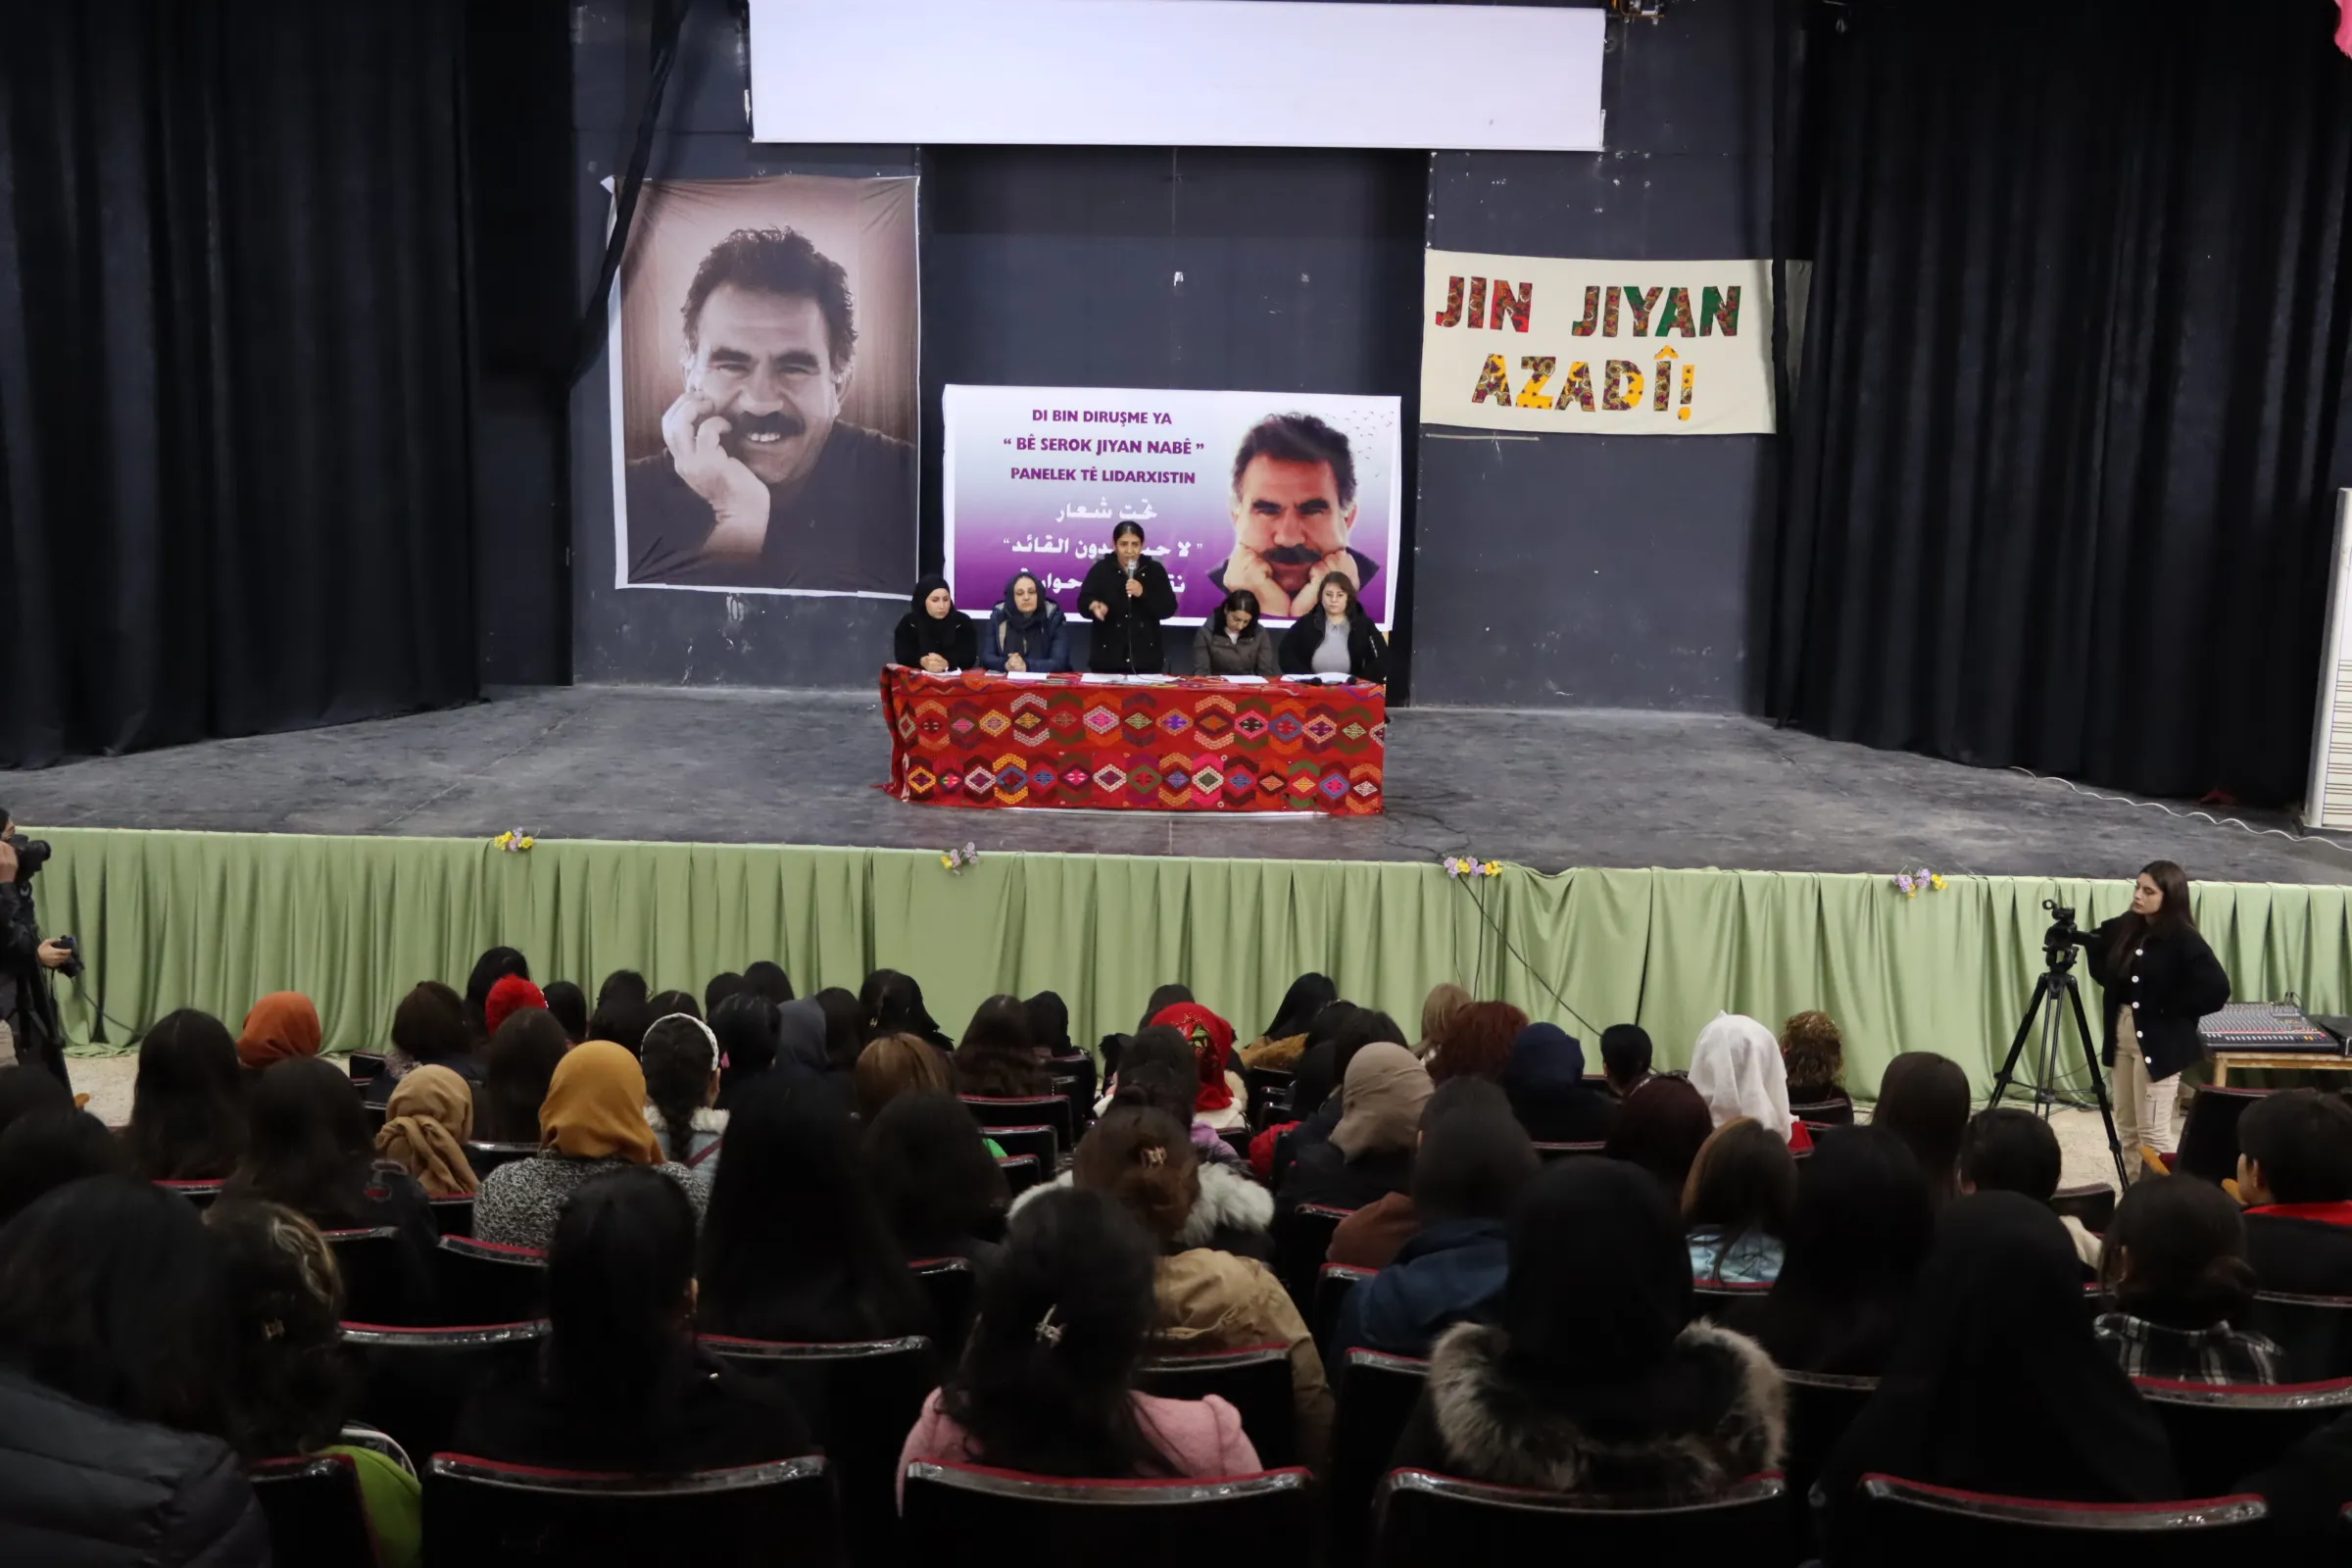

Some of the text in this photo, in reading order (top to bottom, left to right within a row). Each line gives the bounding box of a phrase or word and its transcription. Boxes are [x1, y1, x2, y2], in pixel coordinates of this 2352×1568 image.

[1435, 275, 1741, 338] JIN JIYAN
[1471, 344, 1696, 422] AZADÎ!
[1032, 409, 1173, 427] DI BIN DIRUŞME YA
[1016, 434, 1036, 452] BÊ
[1040, 437, 1093, 453] SEROK
[1095, 439, 1143, 457] JIYAN
[1147, 437, 1192, 455] NABÊ
[1010, 466, 1196, 484] PANELEK TÊ LIDARXISTIN
[1055, 496, 1112, 522] شعار
[1074, 539, 1115, 560] دون
[1177, 540, 1192, 558] لا
